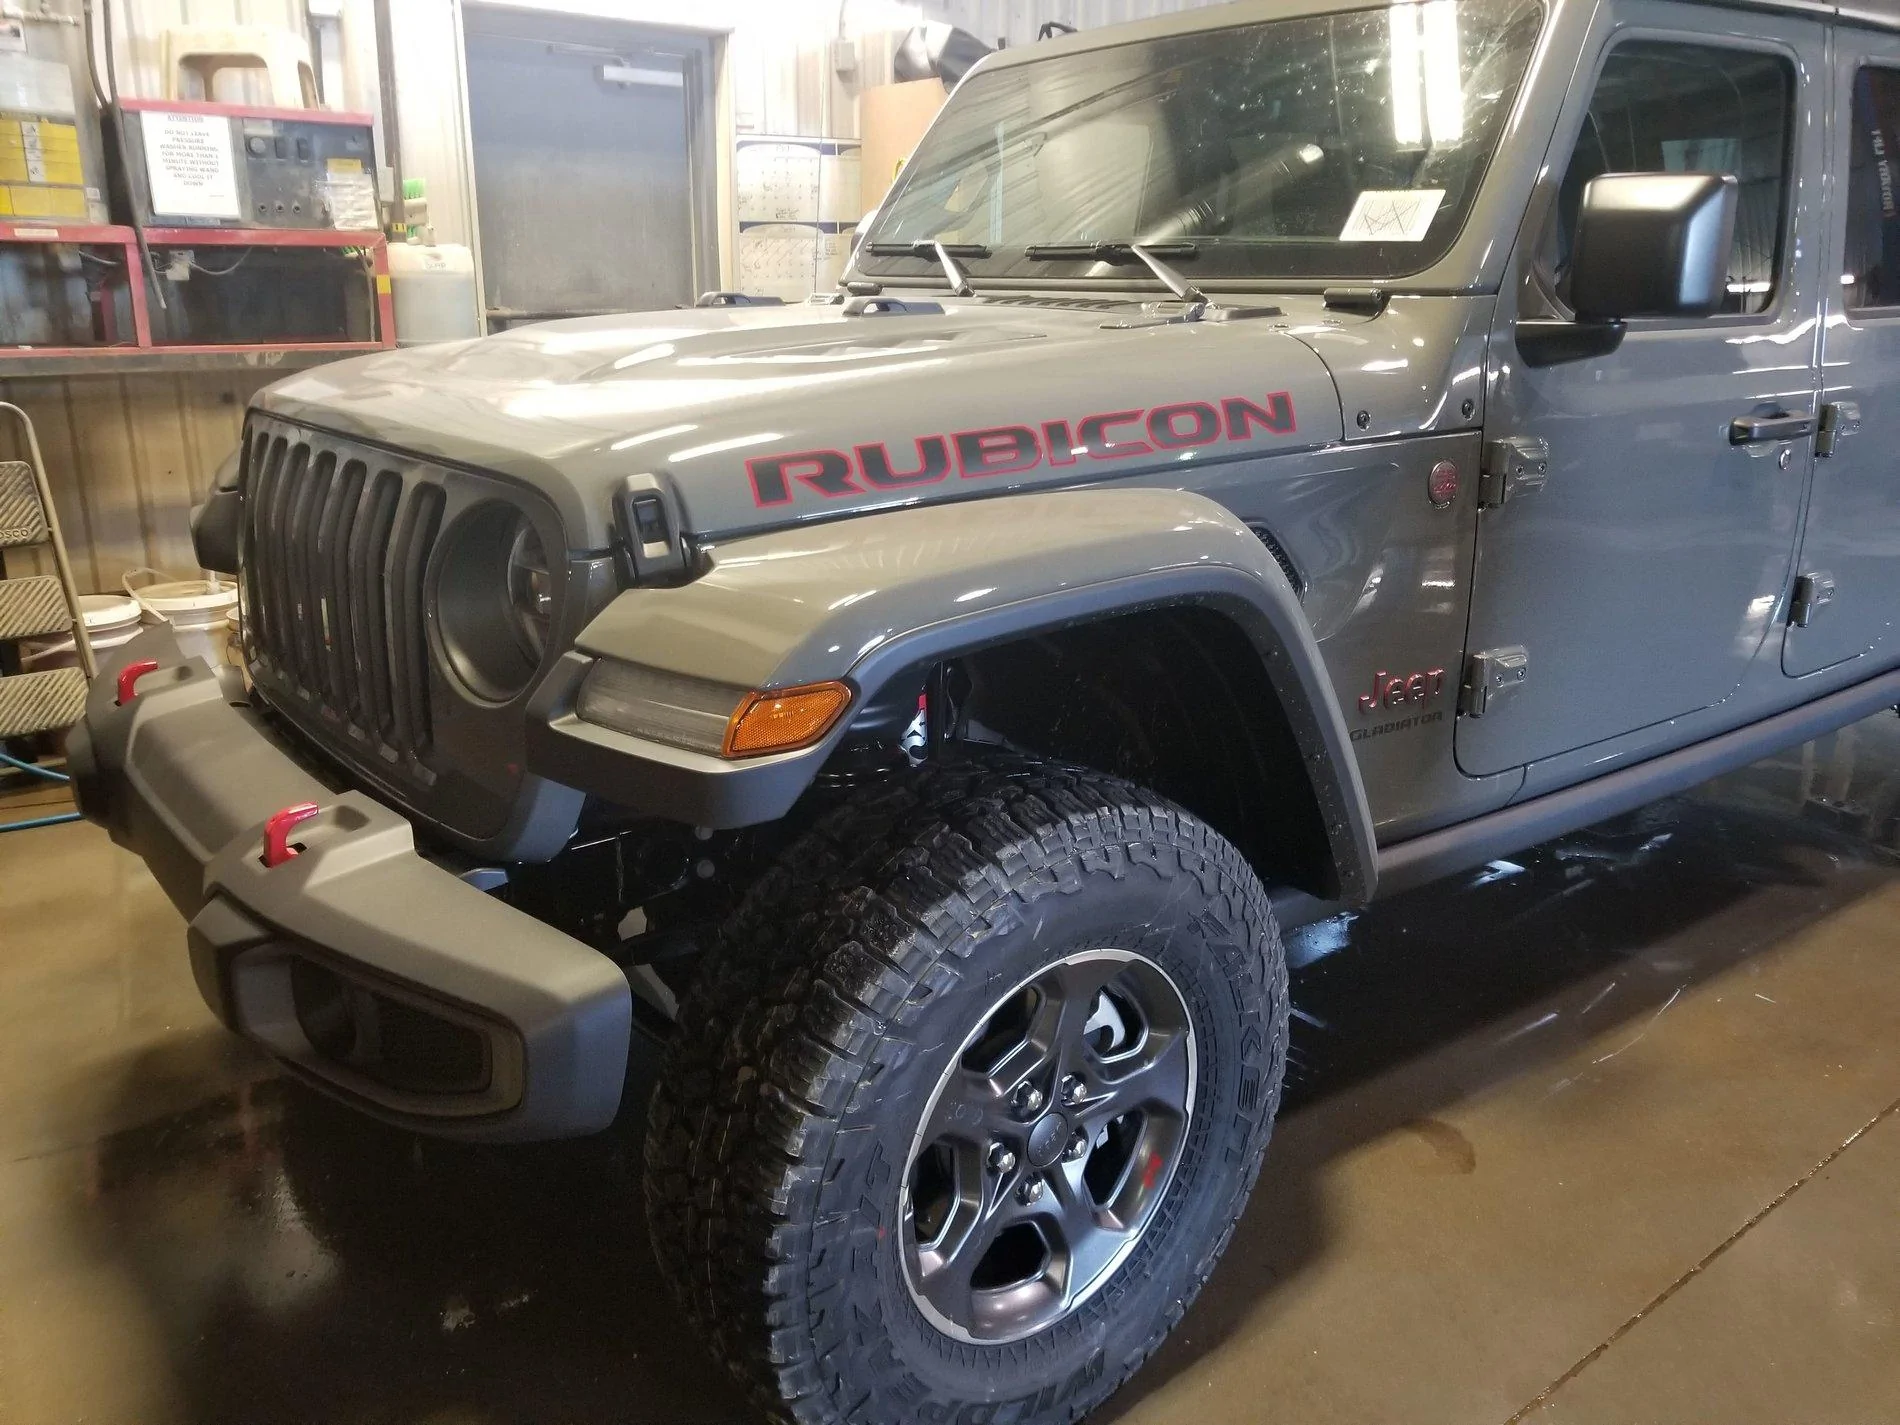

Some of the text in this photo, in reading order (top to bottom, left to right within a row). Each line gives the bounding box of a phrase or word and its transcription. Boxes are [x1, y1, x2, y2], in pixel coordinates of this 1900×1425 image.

[744, 391, 1296, 508] RUBICON
[1358, 667, 1444, 715] Jeep
[1349, 711, 1443, 742] GLADIATOR
